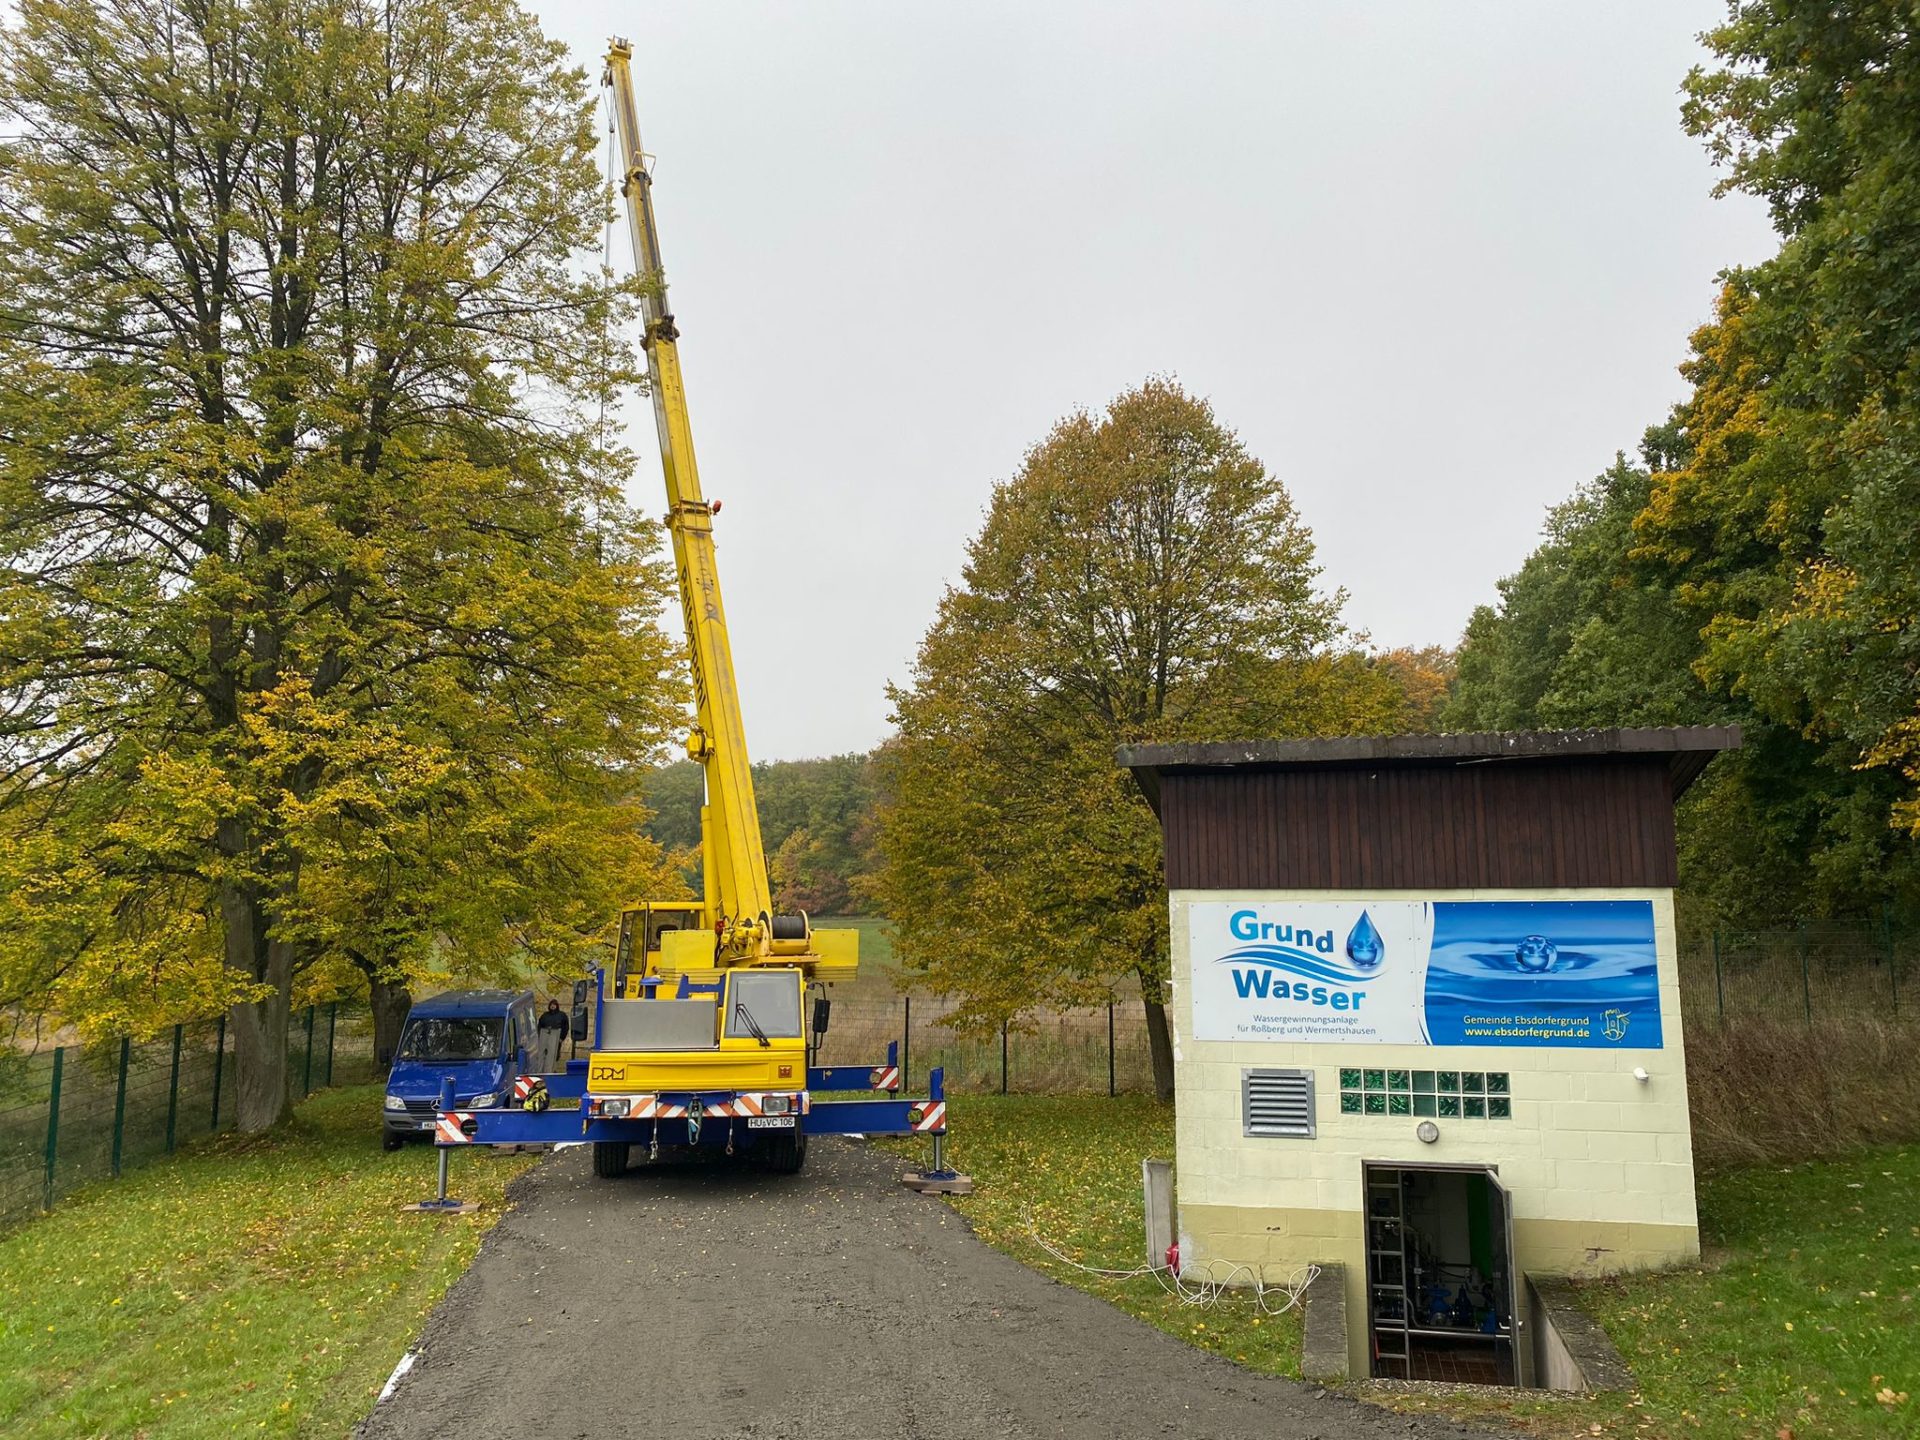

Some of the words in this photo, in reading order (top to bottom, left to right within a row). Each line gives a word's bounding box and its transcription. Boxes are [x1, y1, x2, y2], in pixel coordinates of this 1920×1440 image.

[1229, 910, 1334, 953] Grund
[1231, 969, 1366, 1011] Wasser
[1253, 1015, 1359, 1025] Wassergewinnungsanlage
[1463, 1015, 1513, 1025] Gemeinde
[1515, 1015, 1590, 1026] Ebsdorfergrund
[1251, 1025, 1285, 1034] Roßberg
[1305, 1026, 1376, 1035] Wermertshausen
[1464, 1027, 1590, 1038] www.ebsdorfergrund.de
[592, 1067, 625, 1080] PPM
